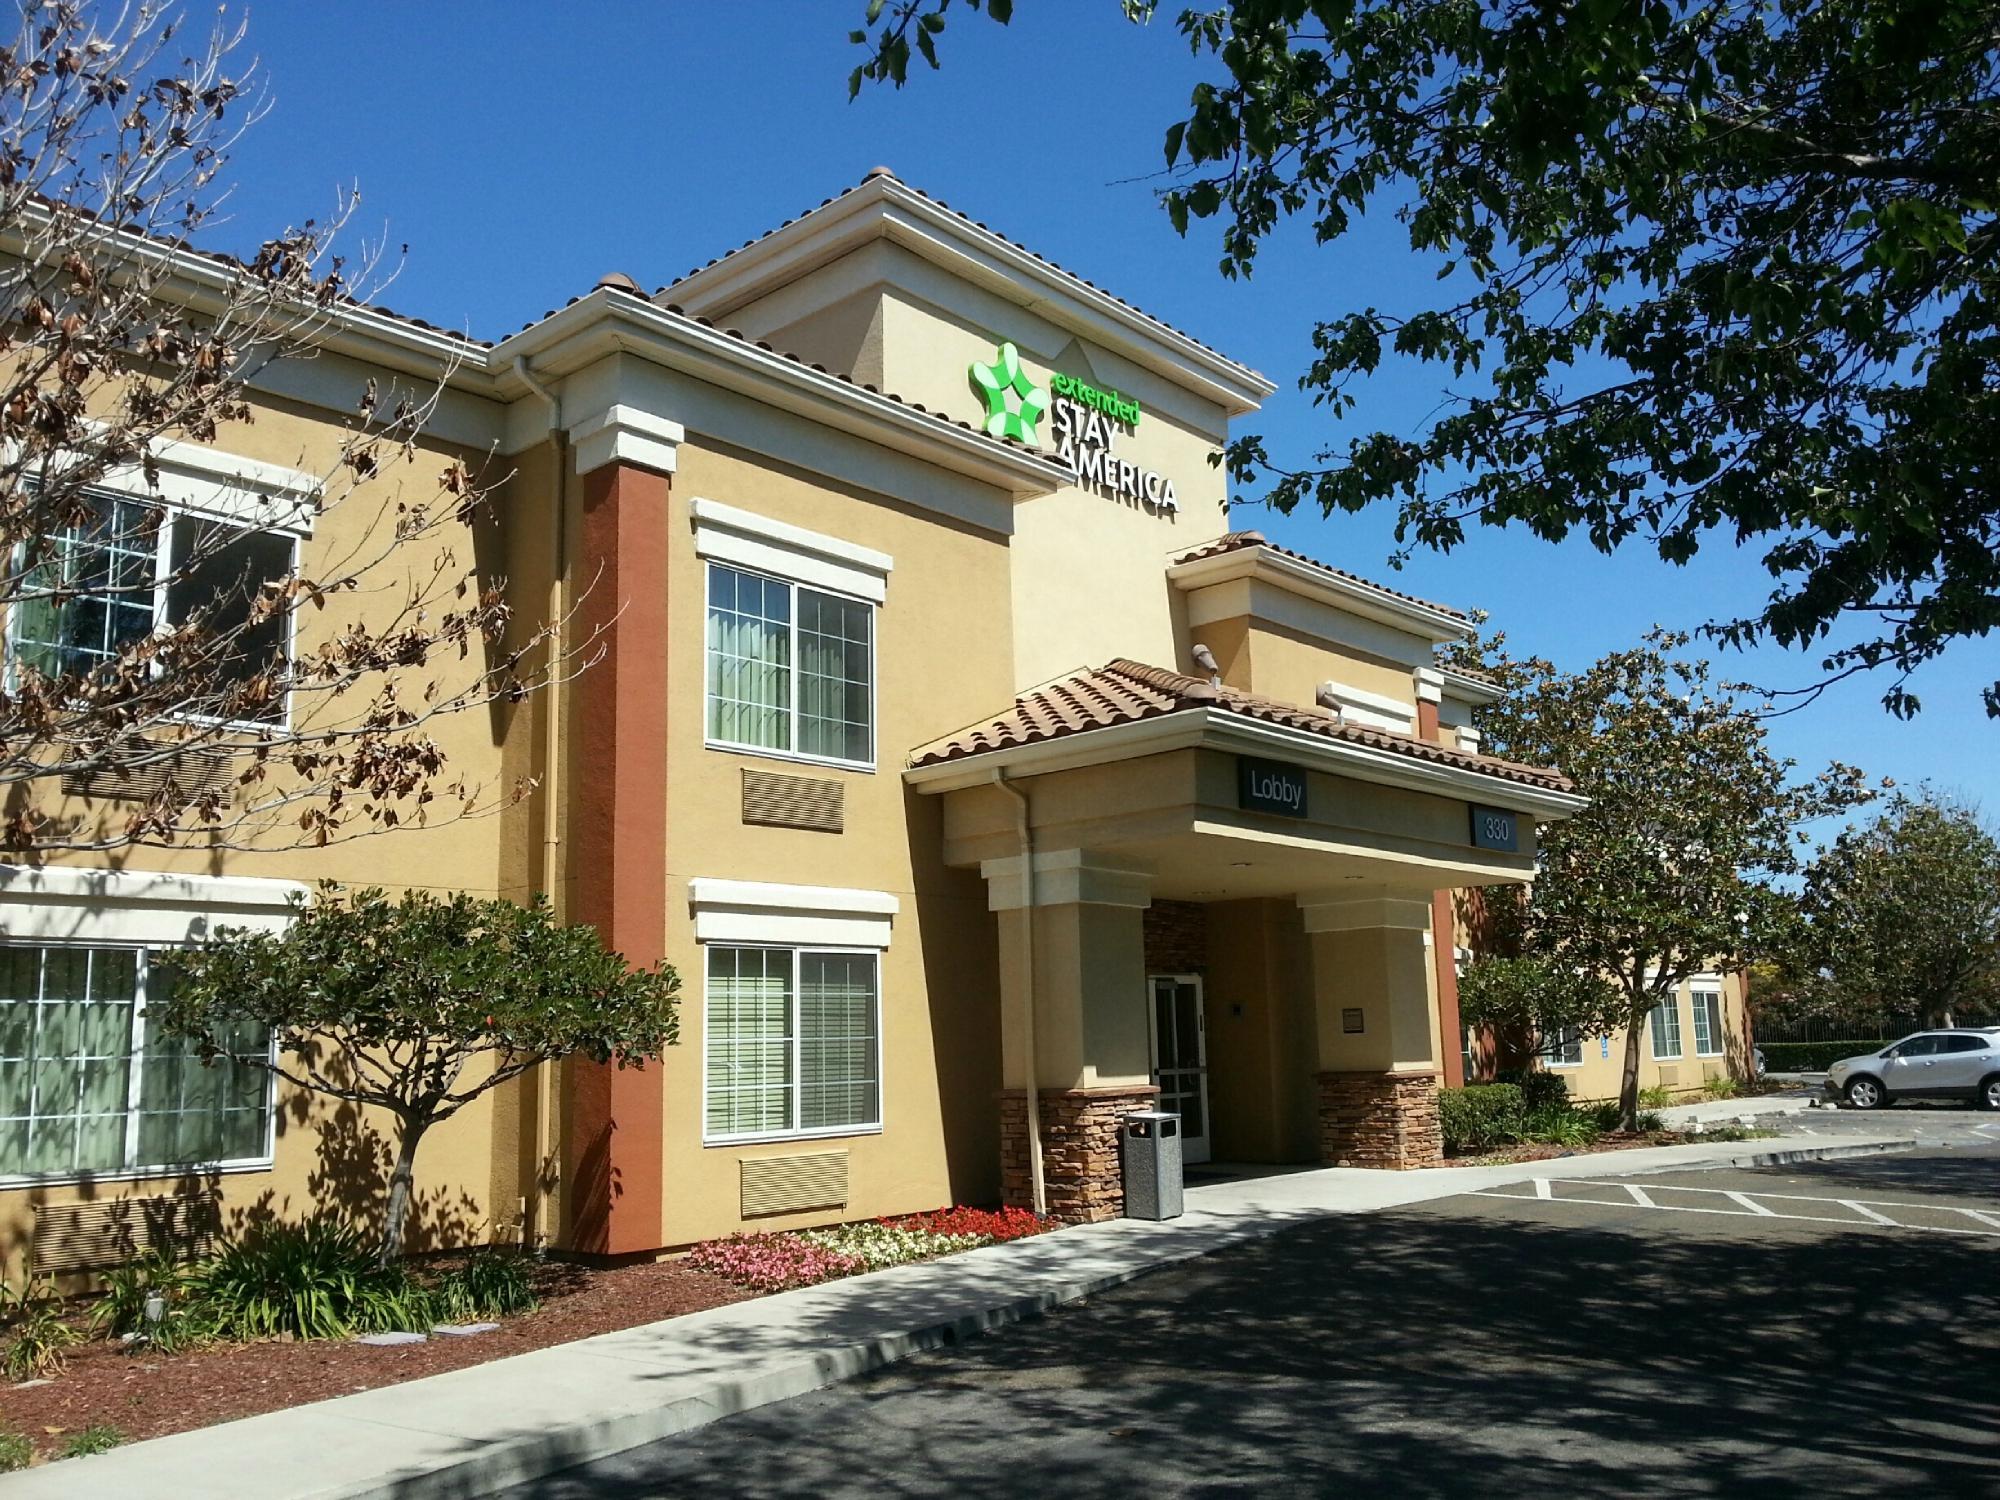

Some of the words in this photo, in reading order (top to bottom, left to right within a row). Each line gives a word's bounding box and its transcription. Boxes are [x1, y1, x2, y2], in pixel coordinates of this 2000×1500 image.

[1052, 373, 1140, 426] extended
[1055, 398, 1120, 451] STAY
[1059, 436, 1180, 514] AMERICA
[1251, 769, 1302, 810] Lobby
[1486, 817, 1509, 841] 330
